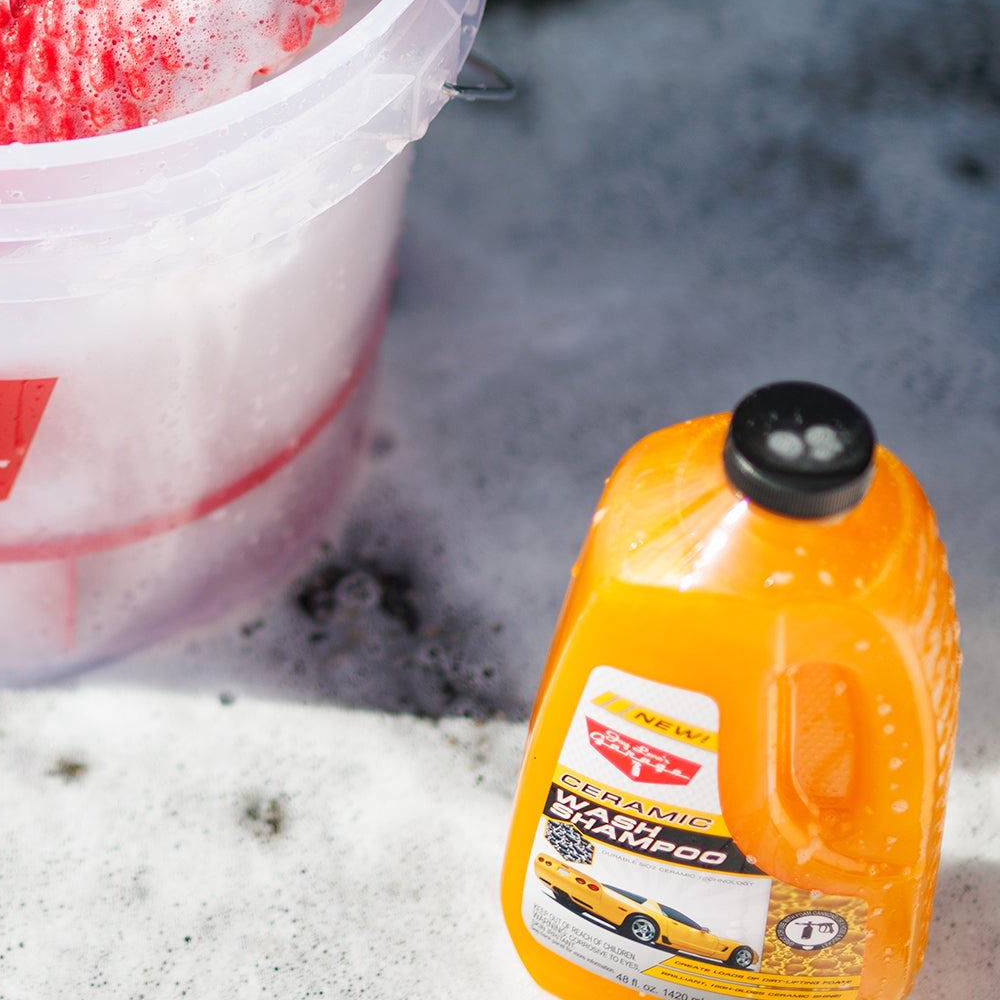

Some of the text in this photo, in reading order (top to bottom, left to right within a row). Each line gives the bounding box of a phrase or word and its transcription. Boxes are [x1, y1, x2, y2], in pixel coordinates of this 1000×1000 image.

[634, 711, 710, 744] NEW!
[556, 788, 662, 838] WASH
[560, 773, 713, 829] CERAMIC
[550, 802, 728, 865] SHAMPOO
[601, 850, 637, 865] DURABLE
[658, 866, 696, 879] CERAMIC
[571, 926, 592, 942] REACH
[592, 937, 602, 946] OF
[608, 953, 619, 963] TO
[674, 960, 711, 973] CREATE
[713, 969, 745, 980] LOADS
[616, 973, 629, 985] 48
[642, 983, 659, 995] oz.
[663, 988, 689, 1000] 1420
[767, 991, 810, 999] CERAMIC
